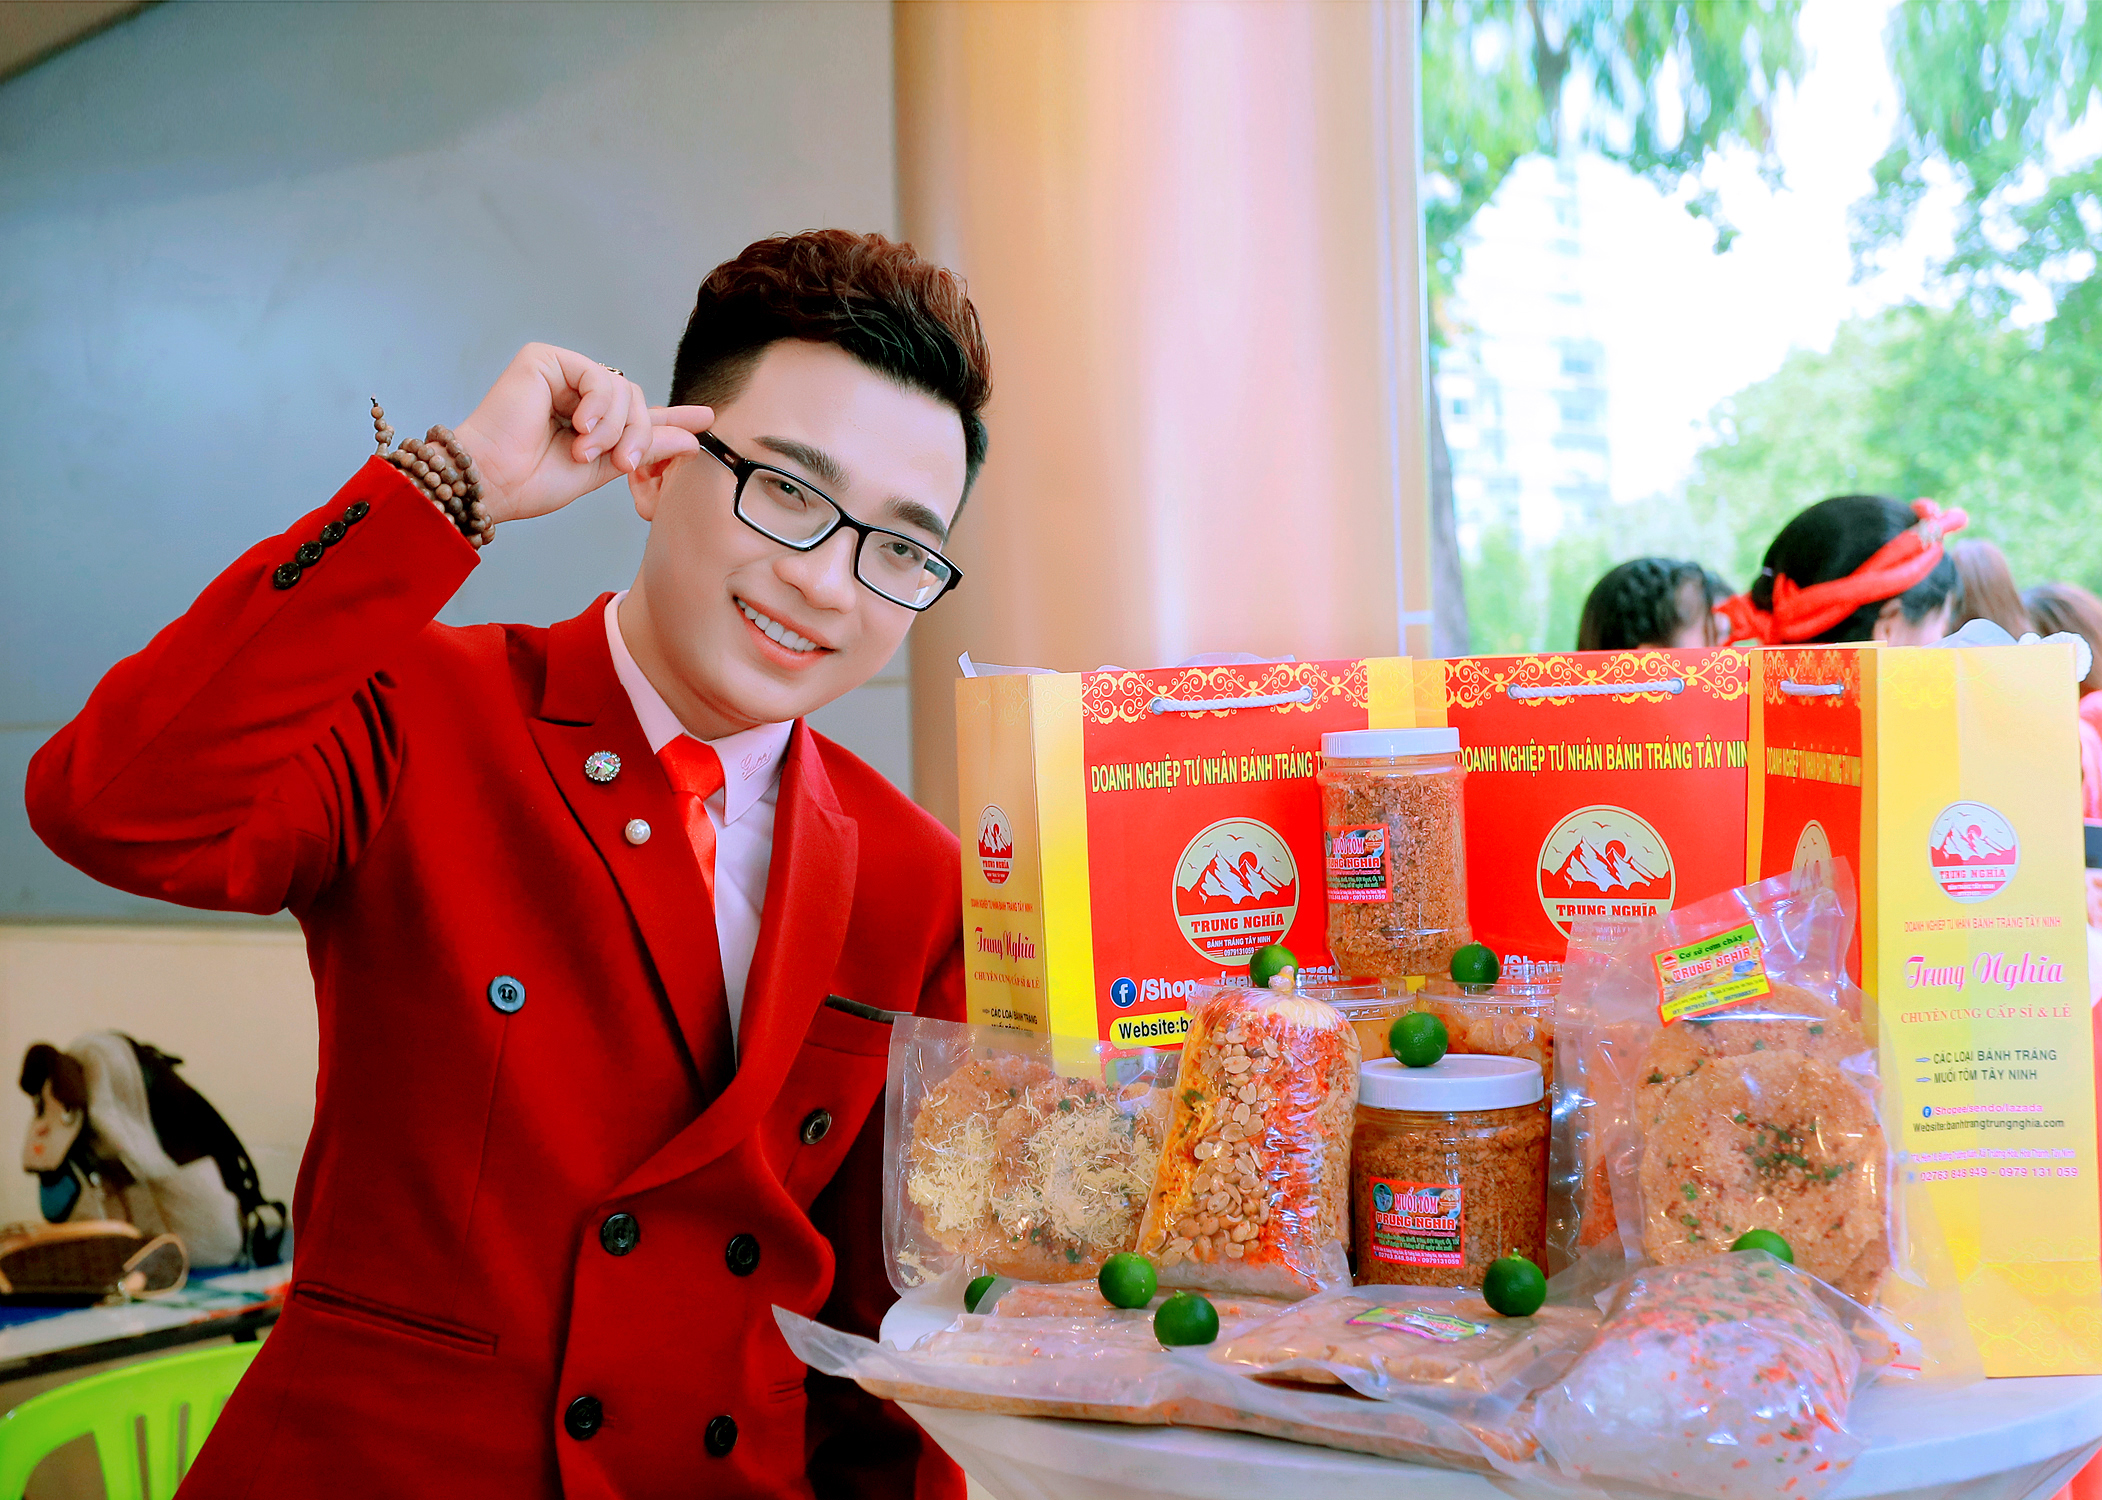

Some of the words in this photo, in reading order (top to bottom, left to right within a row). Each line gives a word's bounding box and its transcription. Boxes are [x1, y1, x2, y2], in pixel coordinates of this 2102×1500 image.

[1500, 738, 1545, 777] NGHIỆP
[1548, 741, 1566, 771] TƯ
[1567, 737, 1603, 771] NHÂN
[1606, 736, 1642, 770] BÁNH
[1645, 735, 1692, 770] TRÁNG
[1695, 734, 1723, 769] TÂY
[1091, 765, 1133, 793] DOANH
[1135, 753, 1180, 793] NGHIỆP
[1184, 757, 1201, 786] TƯ
[1202, 751, 1237, 785] NHÂN
[1240, 748, 1272, 783] BÁNH
[1274, 745, 1314, 780] TRÁNG
[1556, 904, 1606, 917] TRUNG
[1611, 903, 1657, 917] NGHĨA
[1191, 917, 1239, 933] TRUNG
[1243, 911, 1285, 929] NGHĨA
[1206, 938, 1223, 948] BÁNH
[1224, 936, 1244, 947] TRÁNG
[1245, 935, 1256, 945] TÂY
[1257, 935, 1271, 944] NINH
[1679, 951, 1691, 960] Cơ
[1704, 944, 1721, 953] cơm
[1672, 959, 1712, 982] TRUNG
[1715, 946, 1751, 968] NGHĨA
[1905, 955, 1966, 992] Trung
[1971, 952, 2065, 991] Nghĩa
[1901, 1008, 1948, 1023] CHUYÊN
[1950, 1008, 1981, 1020] CUNG
[1986, 1003, 2016, 1018] CẤP
[2037, 1007, 2048, 1018] &
[1933, 1050, 1952, 1064] CÁC
[1953, 1051, 1973, 1064] LOẠI
[1977, 1047, 2011, 1061] BÁNH
[2014, 1047, 2057, 1061] TRÁNG
[1934, 1066, 1956, 1083] MUỐI
[1958, 1067, 1977, 1081] TÔM
[1981, 1066, 2005, 1080] TÂY
[2008, 1069, 2038, 1080] NINH
[1969, 1167, 1987, 1178] 949
[1999, 1167, 2028, 1177] 0979
[2032, 1167, 2051, 1177] 131
[2057, 1167, 2079, 1177] 059
[1394, 1187, 1417, 1212] MUỐI
[1418, 1191, 1438, 1214] TÔM
[1376, 1211, 1412, 1227] TRUNG
[1415, 1216, 1456, 1230] NGHĨA
